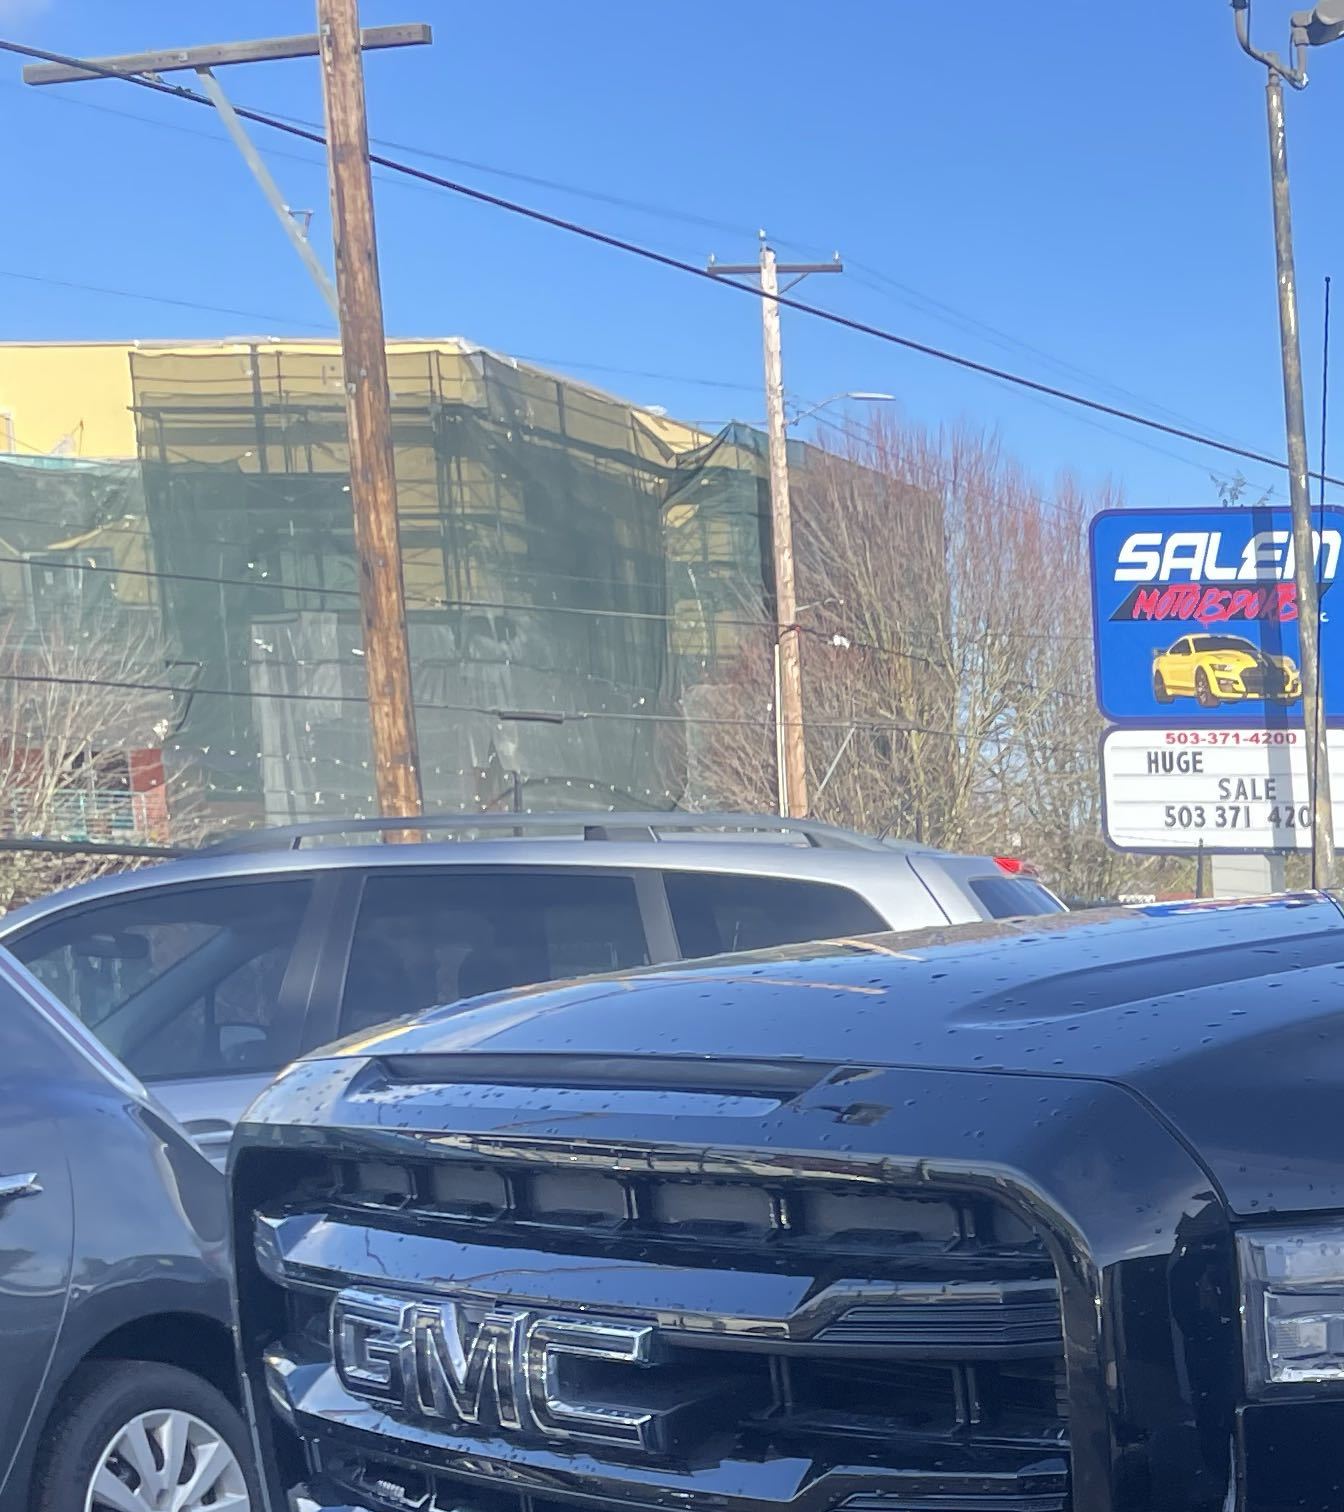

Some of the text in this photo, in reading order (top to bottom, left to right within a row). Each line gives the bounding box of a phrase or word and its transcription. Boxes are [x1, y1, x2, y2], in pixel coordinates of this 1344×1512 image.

[1114, 530, 1342, 581] SALEM
[1165, 732, 1297, 745] 503-371-4200
[1146, 751, 1204, 774] HUGE
[1217, 777, 1277, 801] SALE
[1164, 805, 1313, 829] 503 371 420
[330, 1288, 655, 1450] GMC
